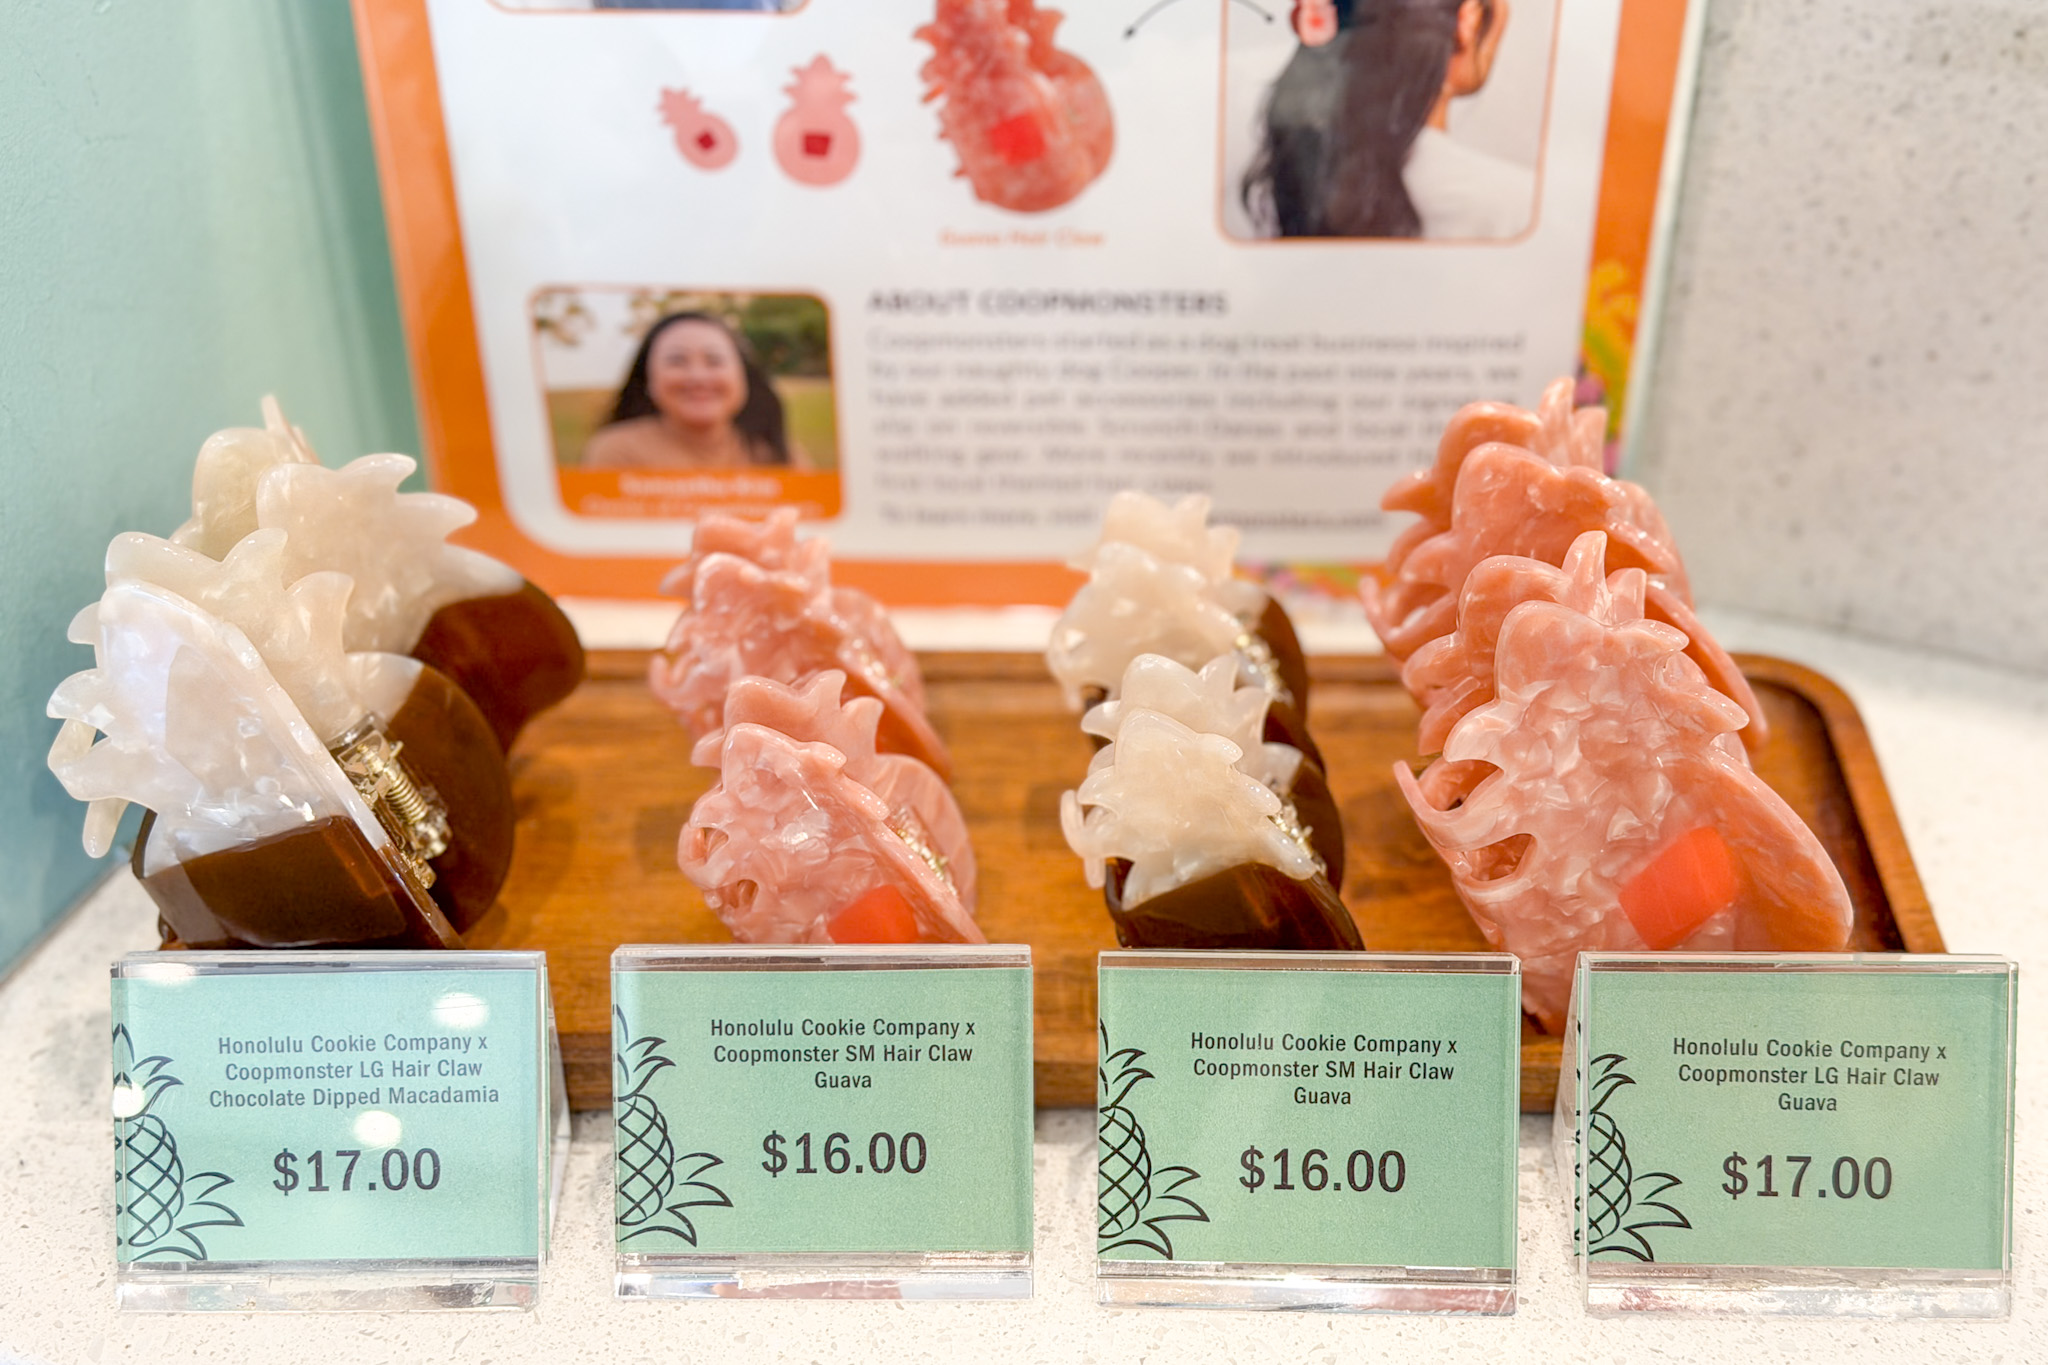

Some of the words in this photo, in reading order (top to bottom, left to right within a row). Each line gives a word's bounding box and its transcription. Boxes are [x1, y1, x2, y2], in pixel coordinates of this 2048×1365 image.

[868, 290, 968, 316] ABOUT
[977, 290, 1228, 317] COOPMONSTERS
[866, 327, 1047, 354] Coopmonsters
[711, 1018, 794, 1037] Honolulu
[801, 1018, 866, 1036] Cookie
[872, 1018, 960, 1040] Company
[965, 1022, 976, 1036] x
[218, 1035, 303, 1055] Honolulu
[311, 1034, 376, 1053] Cookie
[383, 1033, 472, 1055] Company
[478, 1036, 488, 1050] x
[713, 1044, 840, 1067] Coopmonster
[845, 1044, 875, 1063] SM
[883, 1044, 922, 1062] Hair
[928, 1044, 973, 1062] Claw
[1191, 1031, 1274, 1051] Honolulu
[1281, 1033, 1347, 1052] Cookie
[1353, 1034, 1442, 1058] Company
[1446, 1040, 1458, 1054] x
[1673, 1037, 1758, 1057] Honolulu
[1766, 1038, 1833, 1058] Cookie
[1840, 1040, 1931, 1064] Company
[1935, 1045, 1947, 1060] x
[225, 1062, 353, 1084] Coopmonster
[360, 1060, 384, 1078] LG
[392, 1060, 431, 1078] Hair
[437, 1059, 483, 1077] Claw
[814, 1070, 872, 1089] Guava
[1193, 1058, 1320, 1081] Coopmonster
[1325, 1060, 1355, 1079] SM
[1363, 1060, 1403, 1080] Hair
[1408, 1061, 1455, 1081] Claw
[1678, 1063, 1808, 1087] Coopmonster
[1814, 1066, 1839, 1085] LG
[1846, 1067, 1887, 1086] Hair
[1893, 1067, 1940, 1086] Claw
[209, 1089, 306, 1108] Chocolate
[313, 1087, 381, 1110] Dipped
[388, 1085, 499, 1105] Macadamia
[1293, 1086, 1351, 1106] Guava
[1778, 1092, 1837, 1112] Guava
[761, 1129, 927, 1179] $16.00
[272, 1147, 441, 1197] $17.00
[1238, 1144, 1406, 1194] $16.00
[1721, 1150, 1893, 1201] $17.00
